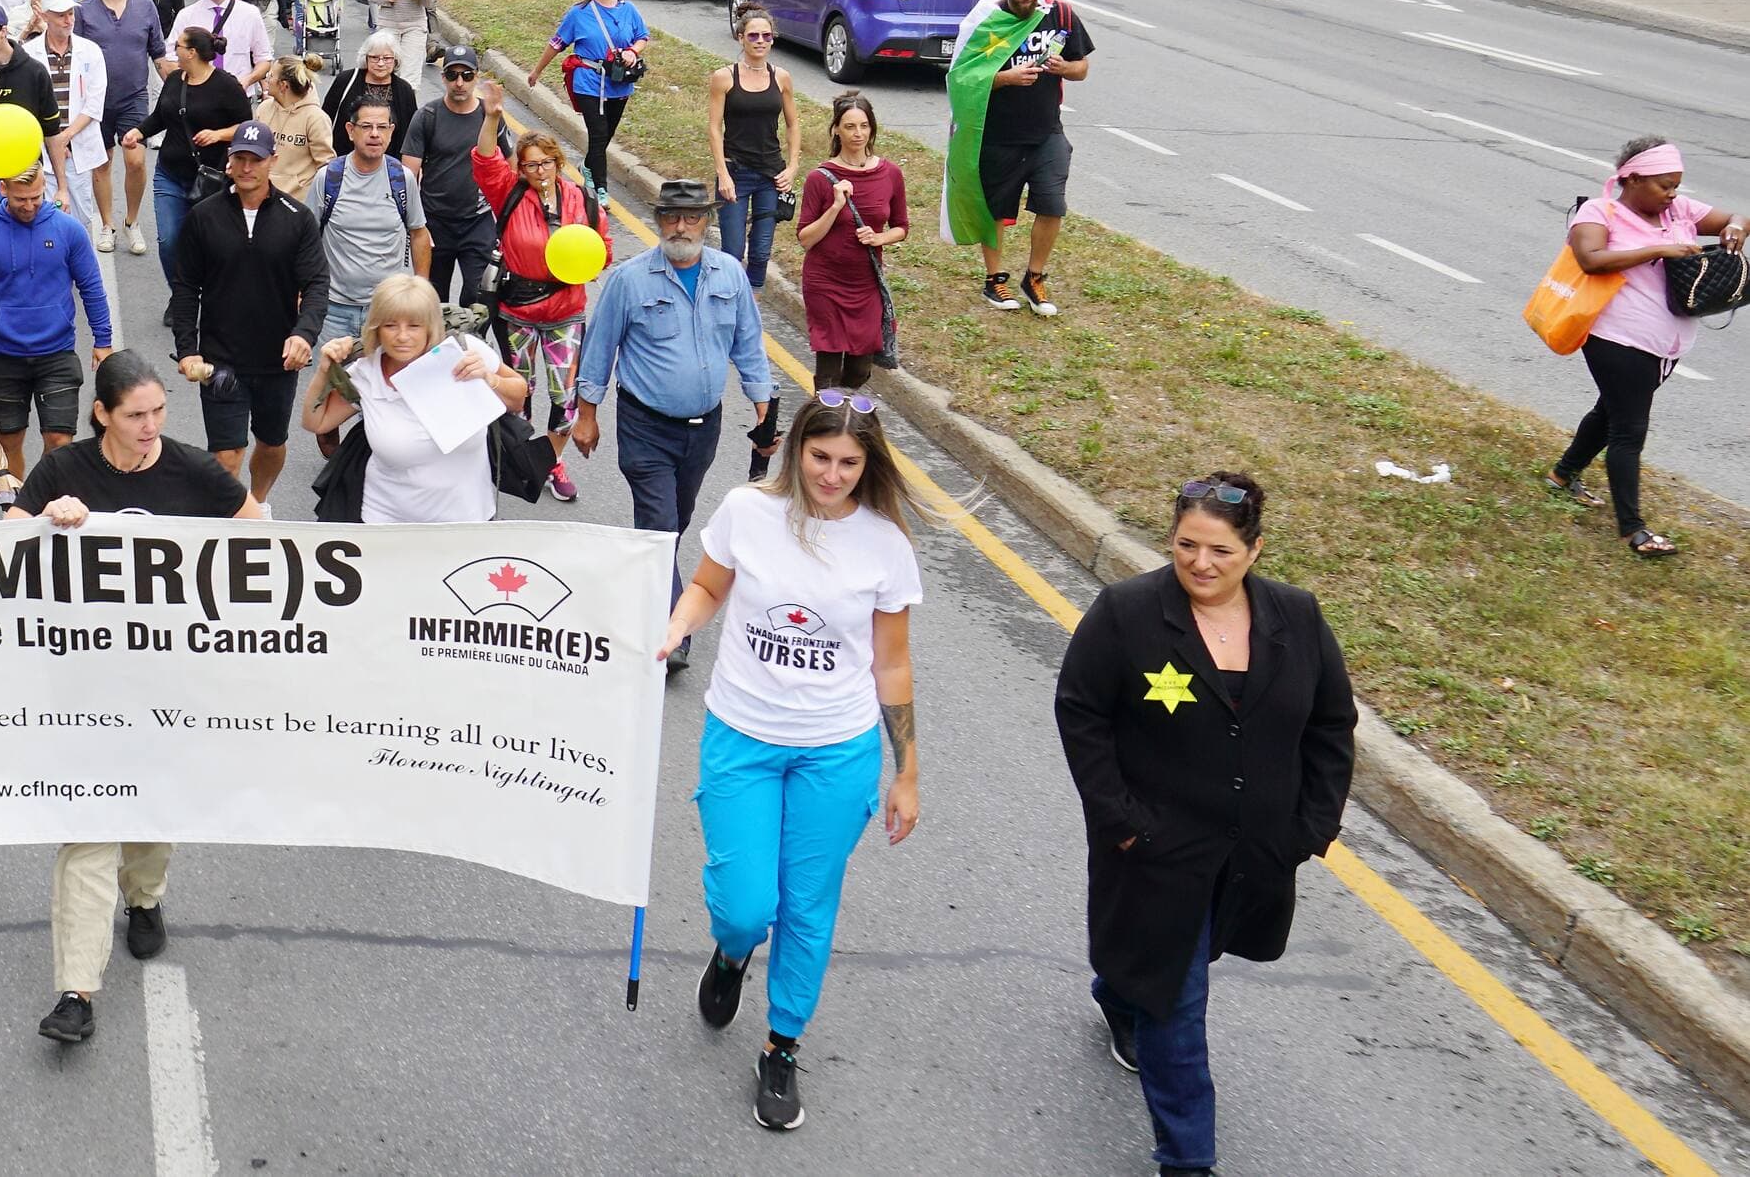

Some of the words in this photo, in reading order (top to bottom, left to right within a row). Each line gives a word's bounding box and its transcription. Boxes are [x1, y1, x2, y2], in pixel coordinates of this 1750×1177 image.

[17, 617, 113, 655] Ligne
[127, 622, 172, 651] Du
[187, 621, 328, 655] Canada
[409, 617, 610, 664] INFIRMIER(E)S
[746, 622, 788, 644] CANADIAN
[791, 636, 842, 650] FRONTLINE
[421, 647, 435, 658] DE
[438, 645, 492, 665] PREMIÈRE
[495, 652, 525, 668] LIGNE
[528, 658, 543, 669] DU
[545, 659, 590, 676] CANADA
[38, 708, 134, 729] nurses.
[150, 708, 197, 730] We
[207, 711, 274, 733] must
[283, 711, 316, 734] be
[326, 713, 441, 748] learning
[449, 722, 483, 747] all
[492, 733, 539, 755] our
[549, 736, 616, 775] lives.
[368, 748, 466, 775] Florence
[468, 760, 609, 808] Nightingale
